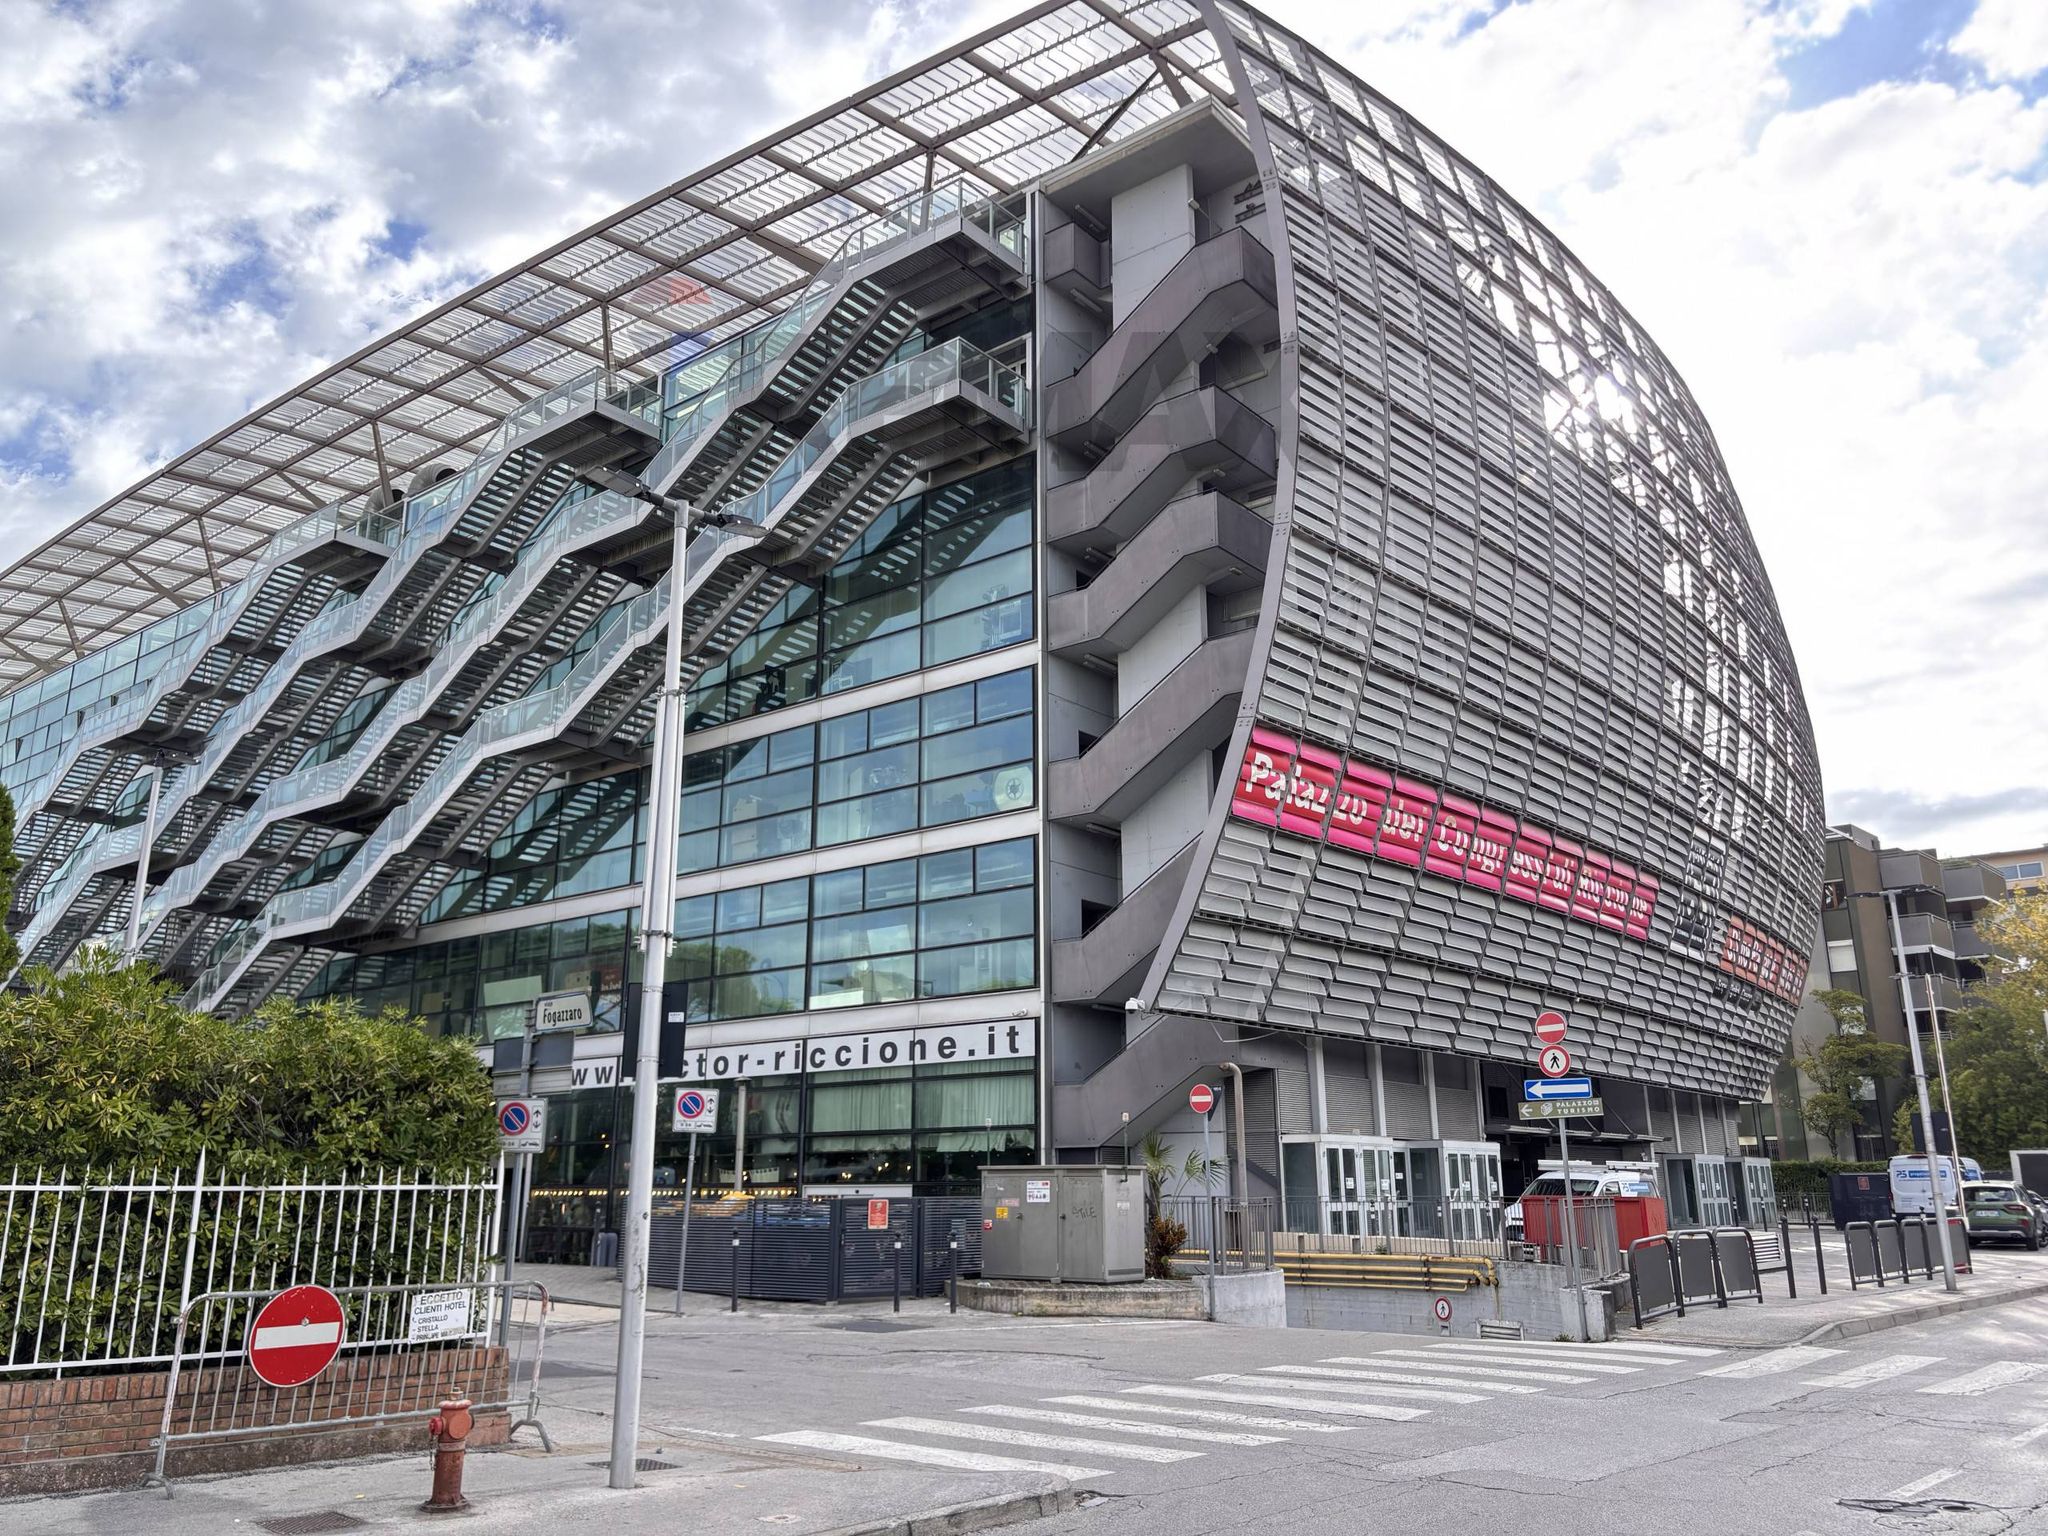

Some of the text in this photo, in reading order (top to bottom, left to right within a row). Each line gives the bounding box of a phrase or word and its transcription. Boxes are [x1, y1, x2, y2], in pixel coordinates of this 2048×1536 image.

[1246, 752, 1368, 826] Palazzo
[1382, 799, 1428, 842] dei
[543, 1008, 583, 1027] Fogazzaro
[1557, 1106, 1600, 1114] TURISMO
[420, 1291, 463, 1305] ECCETTO
[414, 1300, 467, 1315] CLIENTI HOTEL
[418, 1314, 448, 1325] CRISTALLO
[417, 1324, 439, 1333] STELLA
